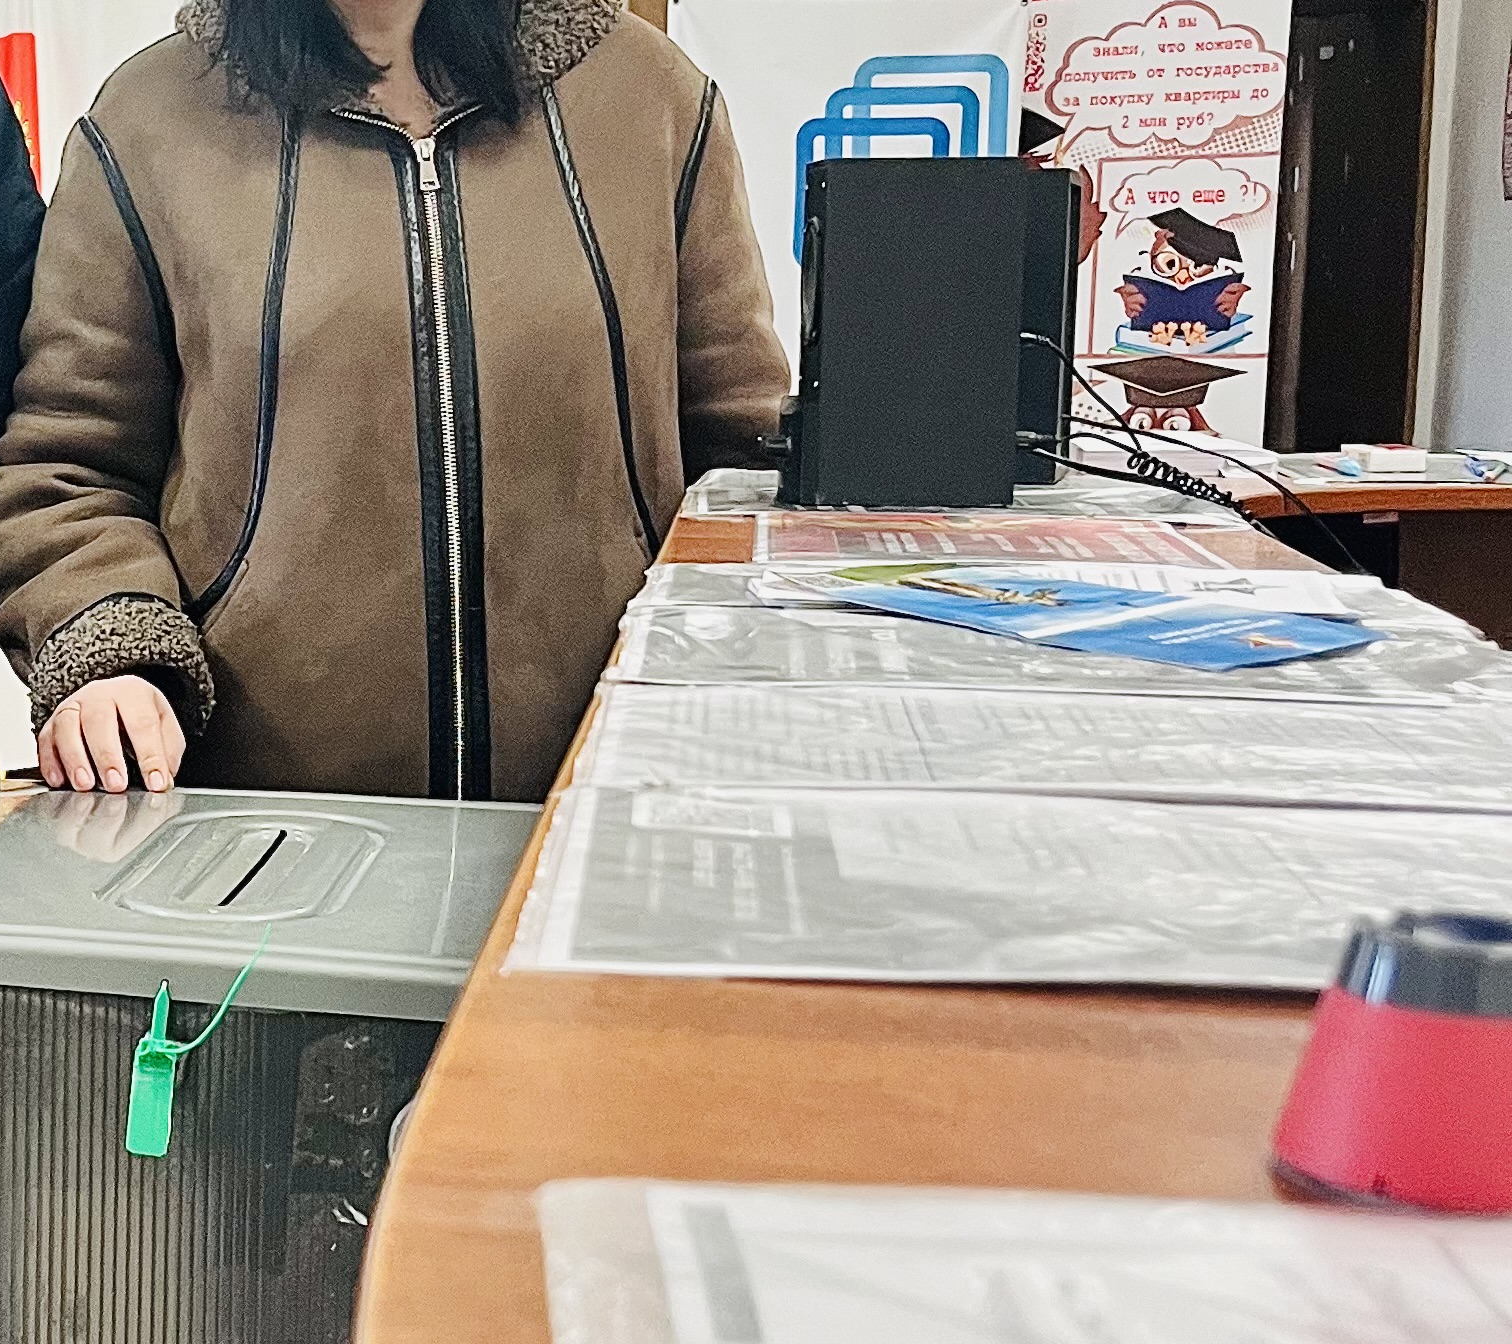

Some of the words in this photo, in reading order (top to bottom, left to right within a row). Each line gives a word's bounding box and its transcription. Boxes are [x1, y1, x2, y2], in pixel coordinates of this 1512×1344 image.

[1158, 16, 1168, 29] А
[1092, 45, 1145, 58] знали,
[1157, 42, 1186, 54] что
[1063, 69, 1137, 85] получить
[1146, 68, 1165, 79] от
[1176, 61, 1279, 80] государства
[1062, 96, 1081, 107] за
[1089, 93, 1154, 109] покупку
[1164, 89, 1241, 106] квартиры
[1250, 87, 1270, 102] до
[1121, 115, 1130, 129] 2
[1139, 117, 1168, 128] млн
[1176, 112, 1215, 131] руб?
[1124, 187, 1136, 204] А
[1147, 189, 1181, 204] что
[1192, 188, 1226, 205] еще
